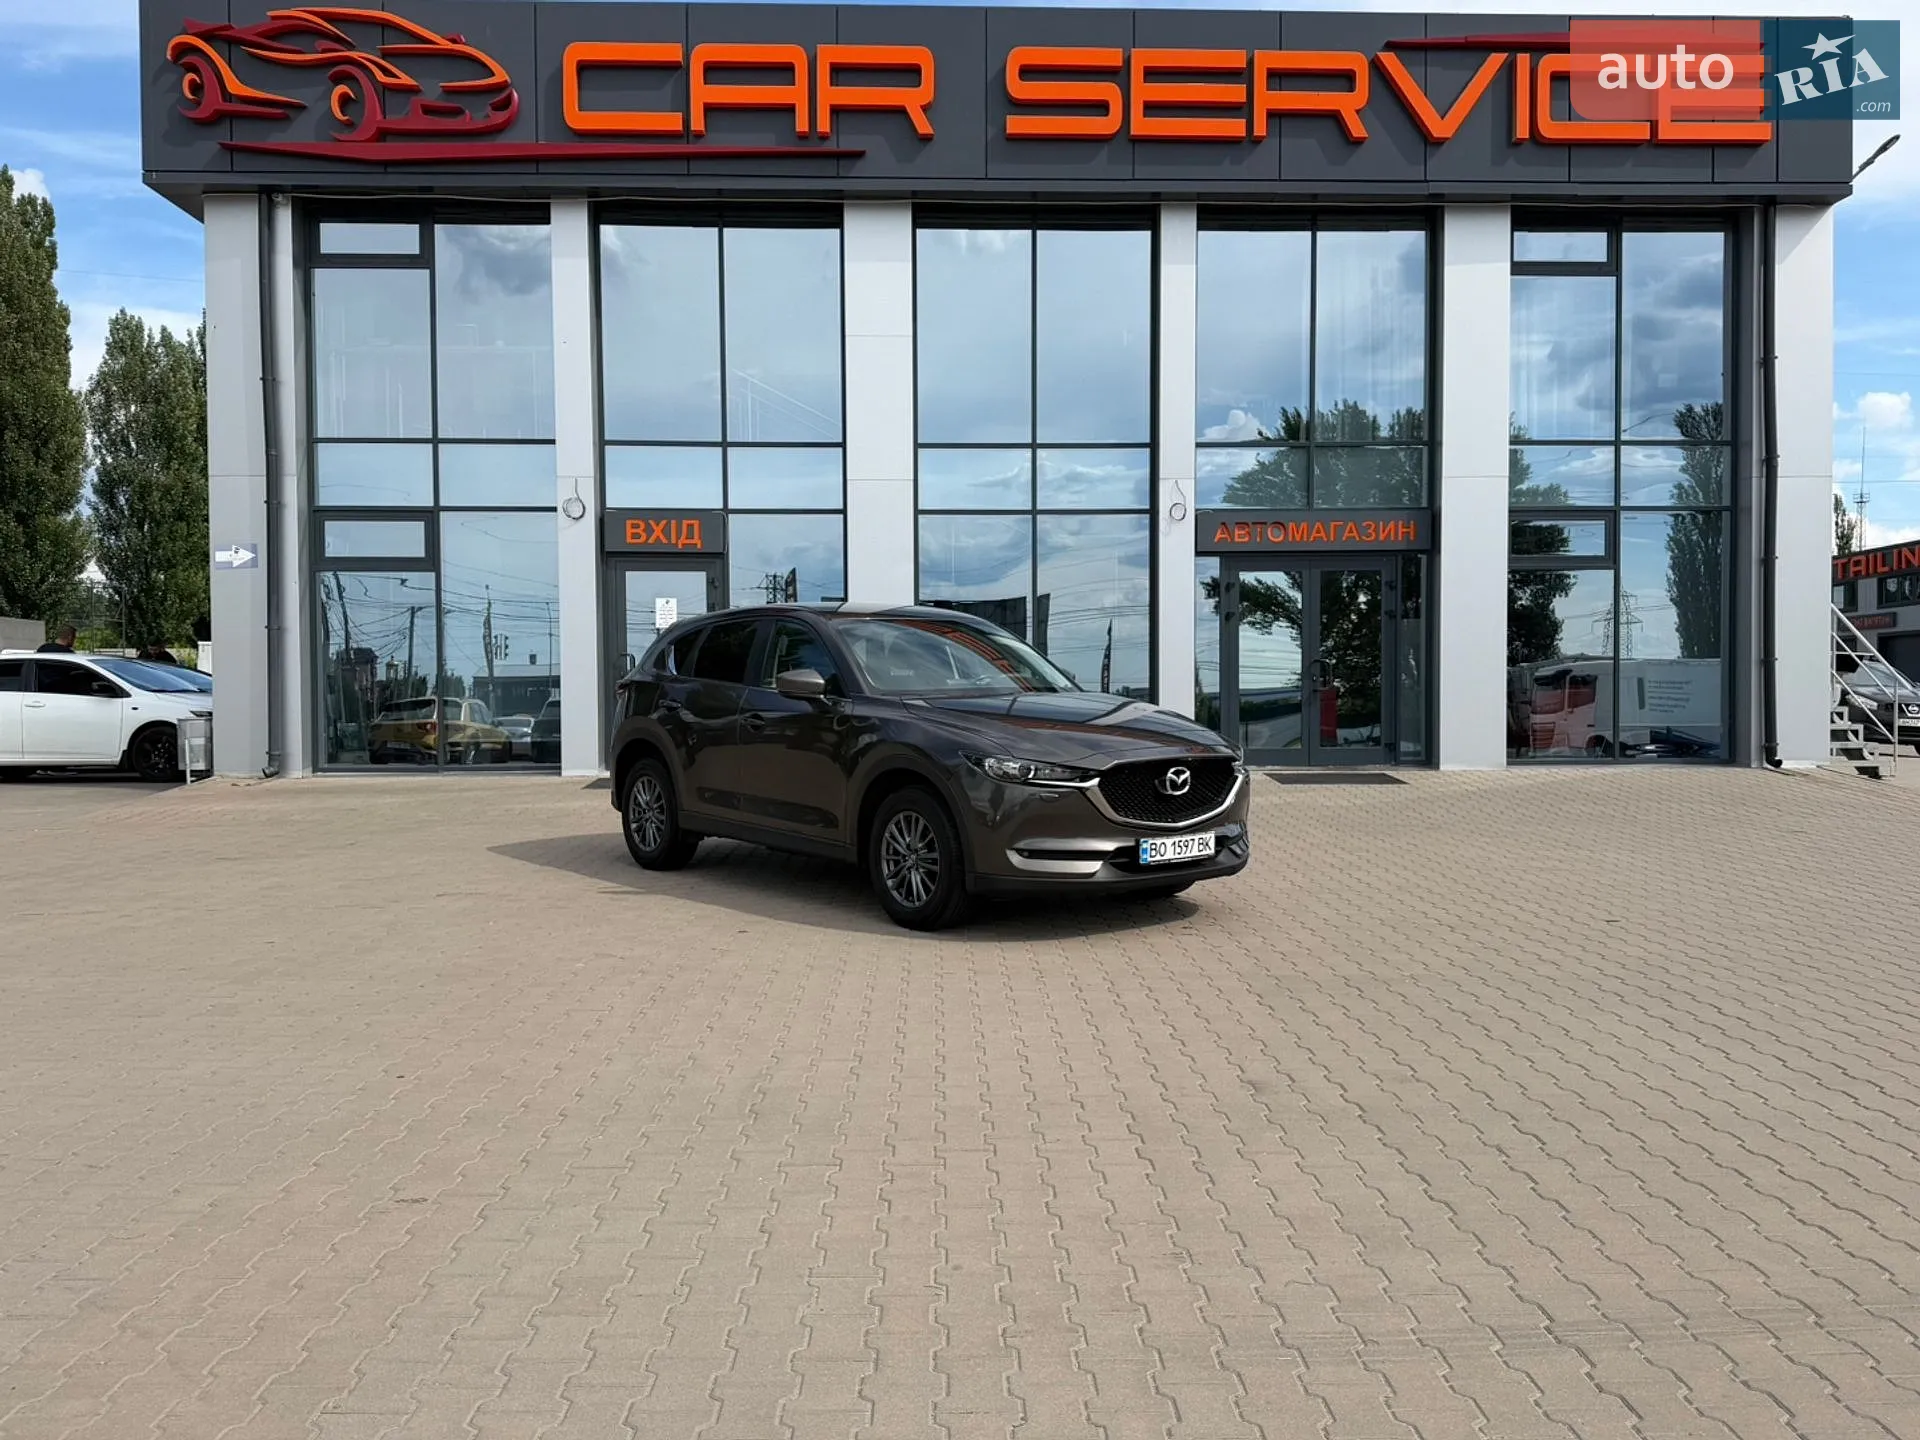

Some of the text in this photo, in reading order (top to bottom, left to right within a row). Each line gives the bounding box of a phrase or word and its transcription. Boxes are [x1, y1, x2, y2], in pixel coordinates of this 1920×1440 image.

[562, 41, 1773, 146] CAR SERVICE
[625, 519, 703, 549] ВХІД
[1214, 520, 1417, 544] АВТОМАГАЗИН
[1149, 835, 1212, 858] BO 1597 BK
